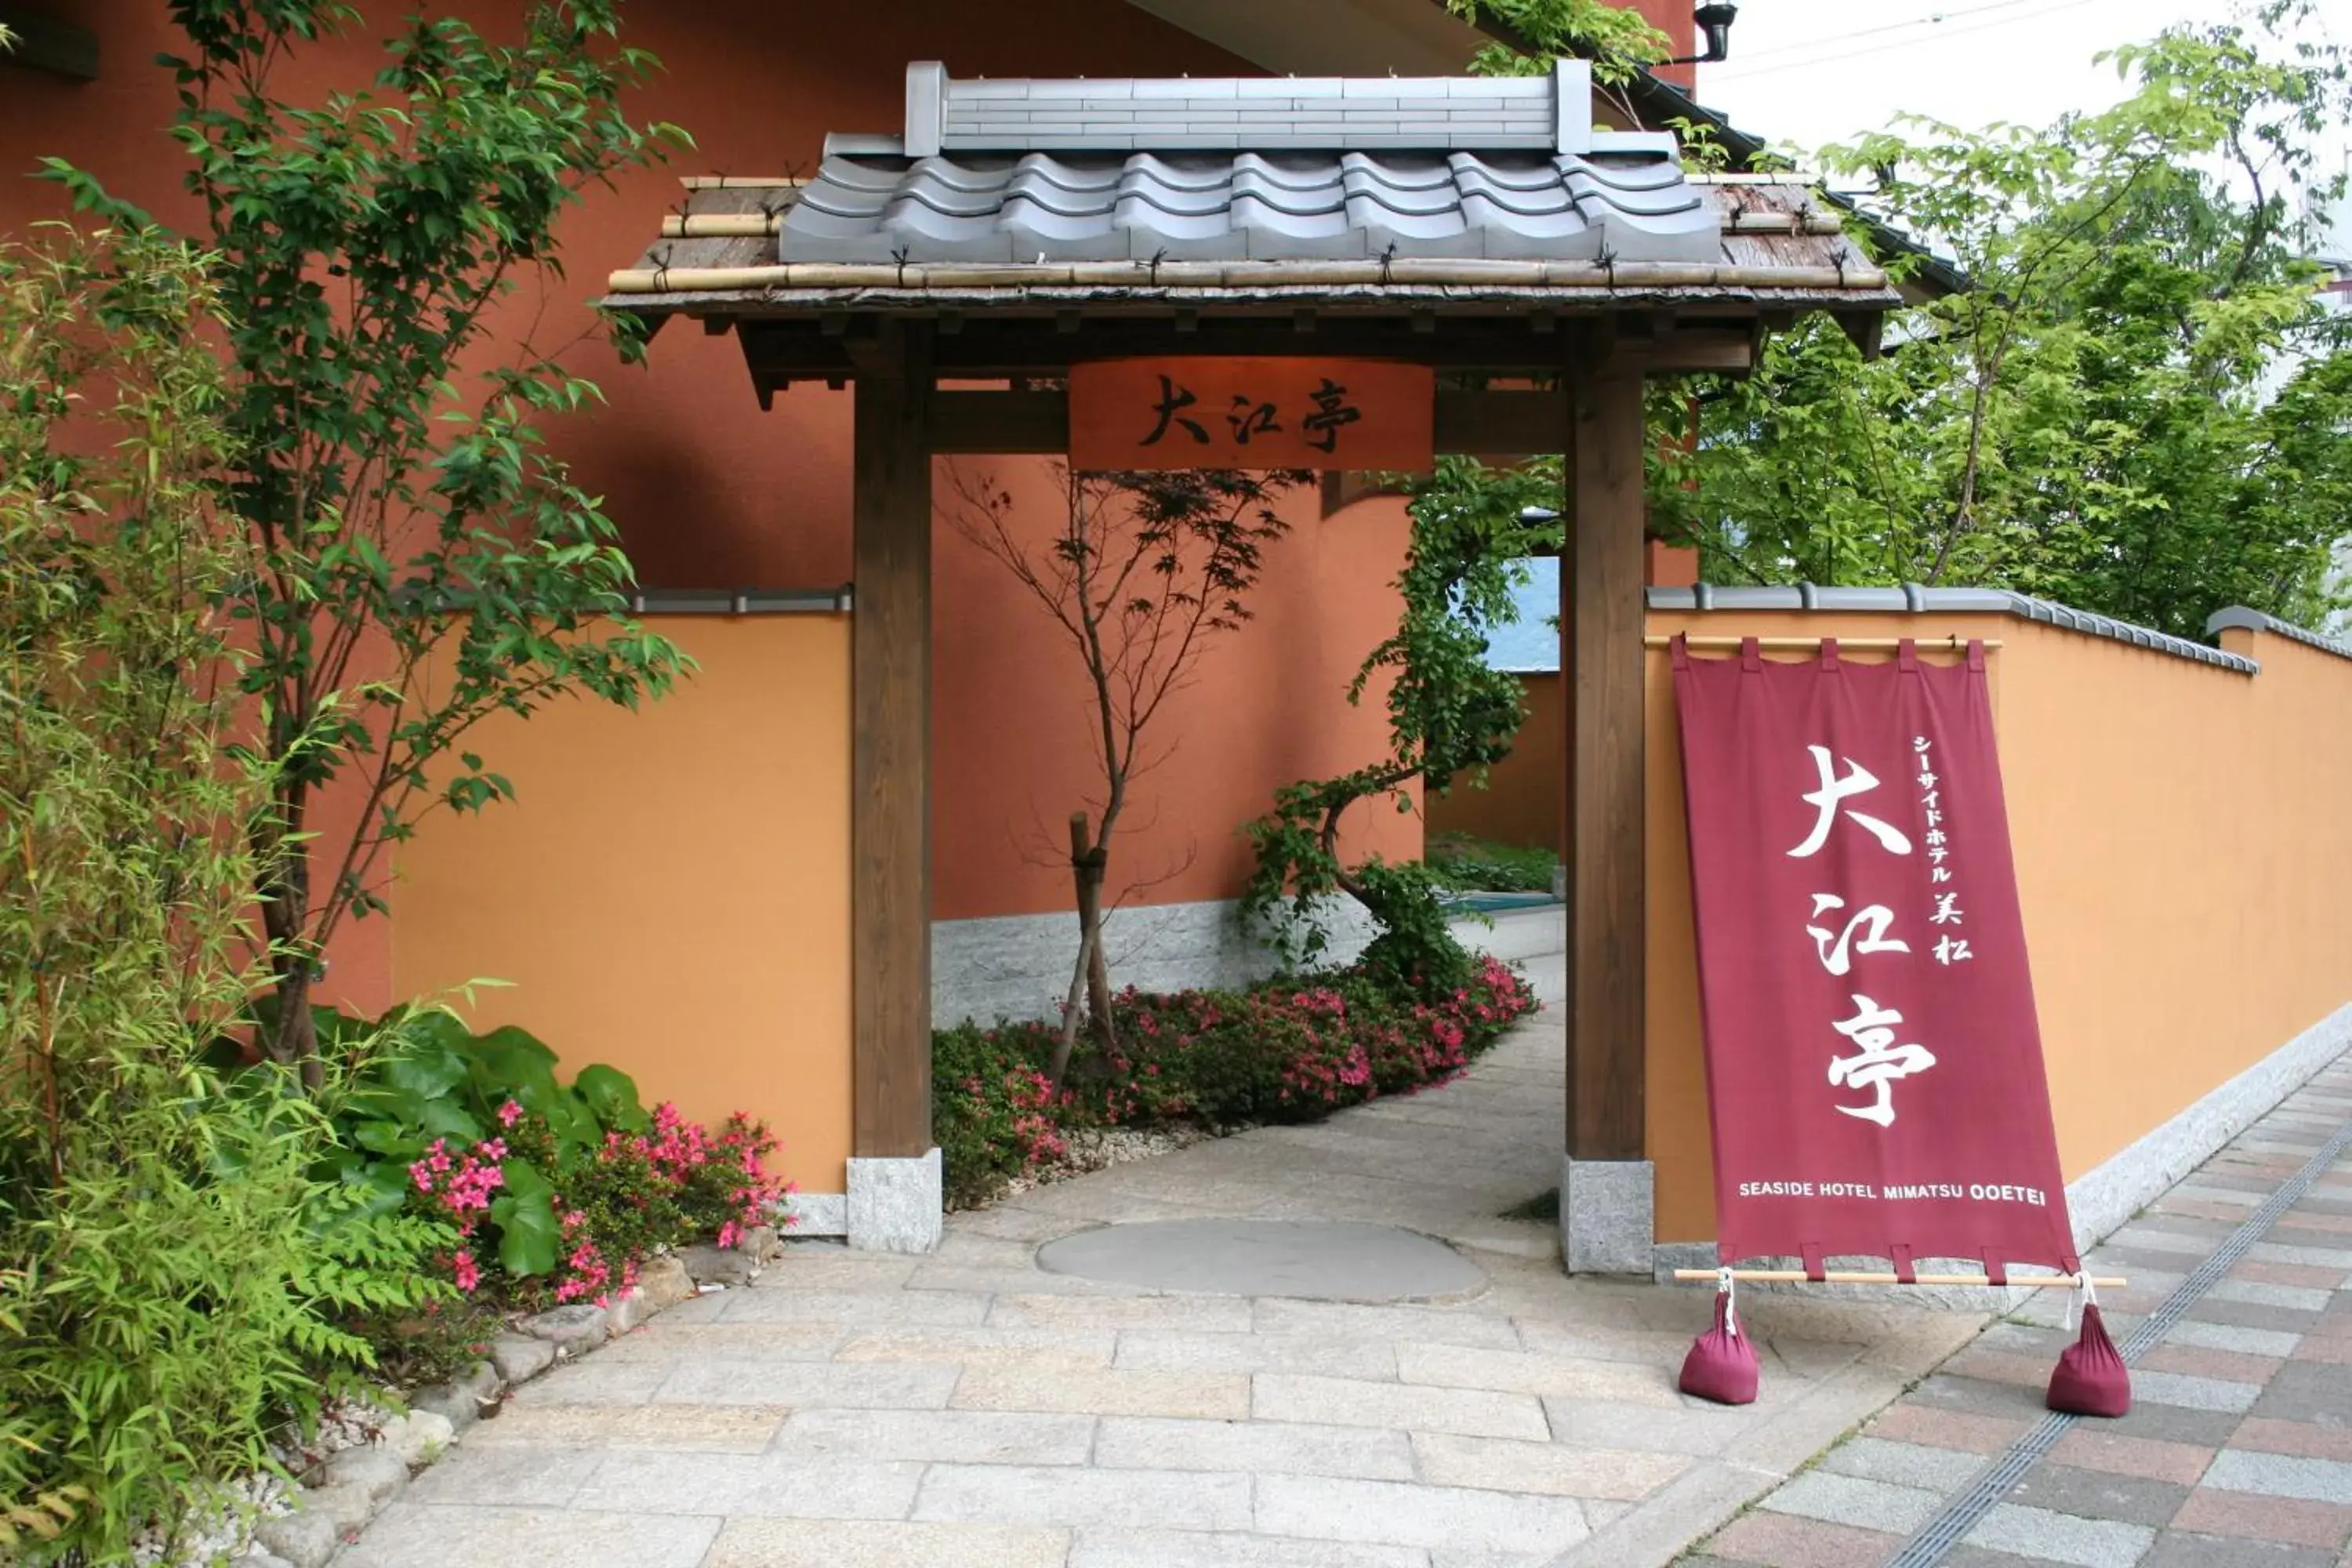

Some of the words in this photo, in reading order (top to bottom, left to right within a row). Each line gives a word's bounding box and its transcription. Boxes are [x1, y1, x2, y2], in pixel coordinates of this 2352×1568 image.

[1139, 375, 1362, 454] 大江亭
[1786, 743, 1937, 1128] 大江亭
[1739, 1181, 1814, 1197] SEASIDE
[1819, 1181, 1877, 1199] HOTEL
[1883, 1183, 1963, 1200] MIMATSU
[1969, 1183, 2046, 1207] OOETEI
